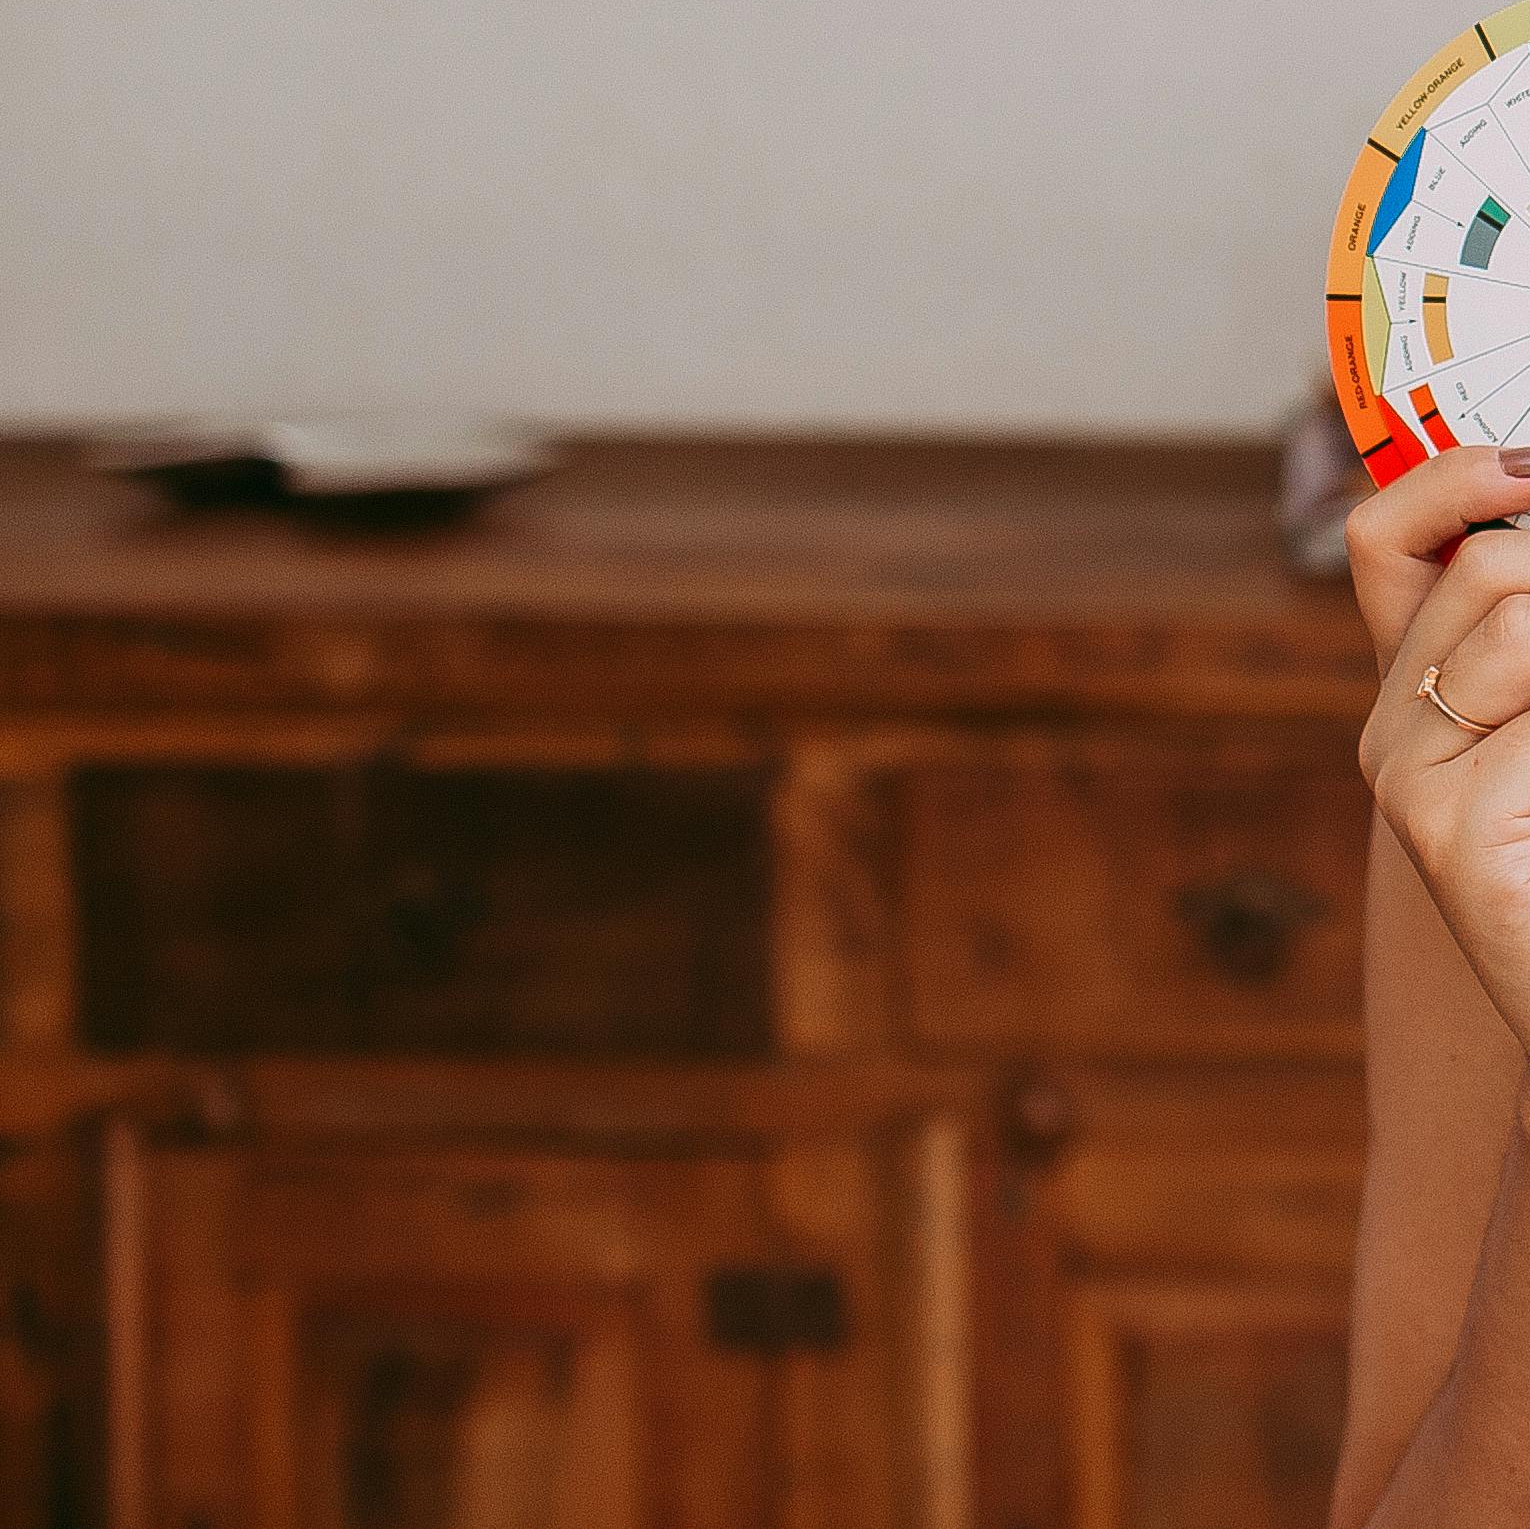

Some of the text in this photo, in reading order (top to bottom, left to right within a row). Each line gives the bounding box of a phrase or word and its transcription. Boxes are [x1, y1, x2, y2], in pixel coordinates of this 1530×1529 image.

[1395, 58, 1466, 131] YELLOW-ORANGE
[1459, 119, 1488, 150] ADDING
[1347, 203, 1367, 252] ORANGE
[1405, 168, 1446, 251] ADDING BLUE
[1398, 271, 1414, 372] ADDING YELLOW
[1344, 334, 1368, 410] RED-ORANGE
[1456, 381, 1499, 443] ADDING RED
